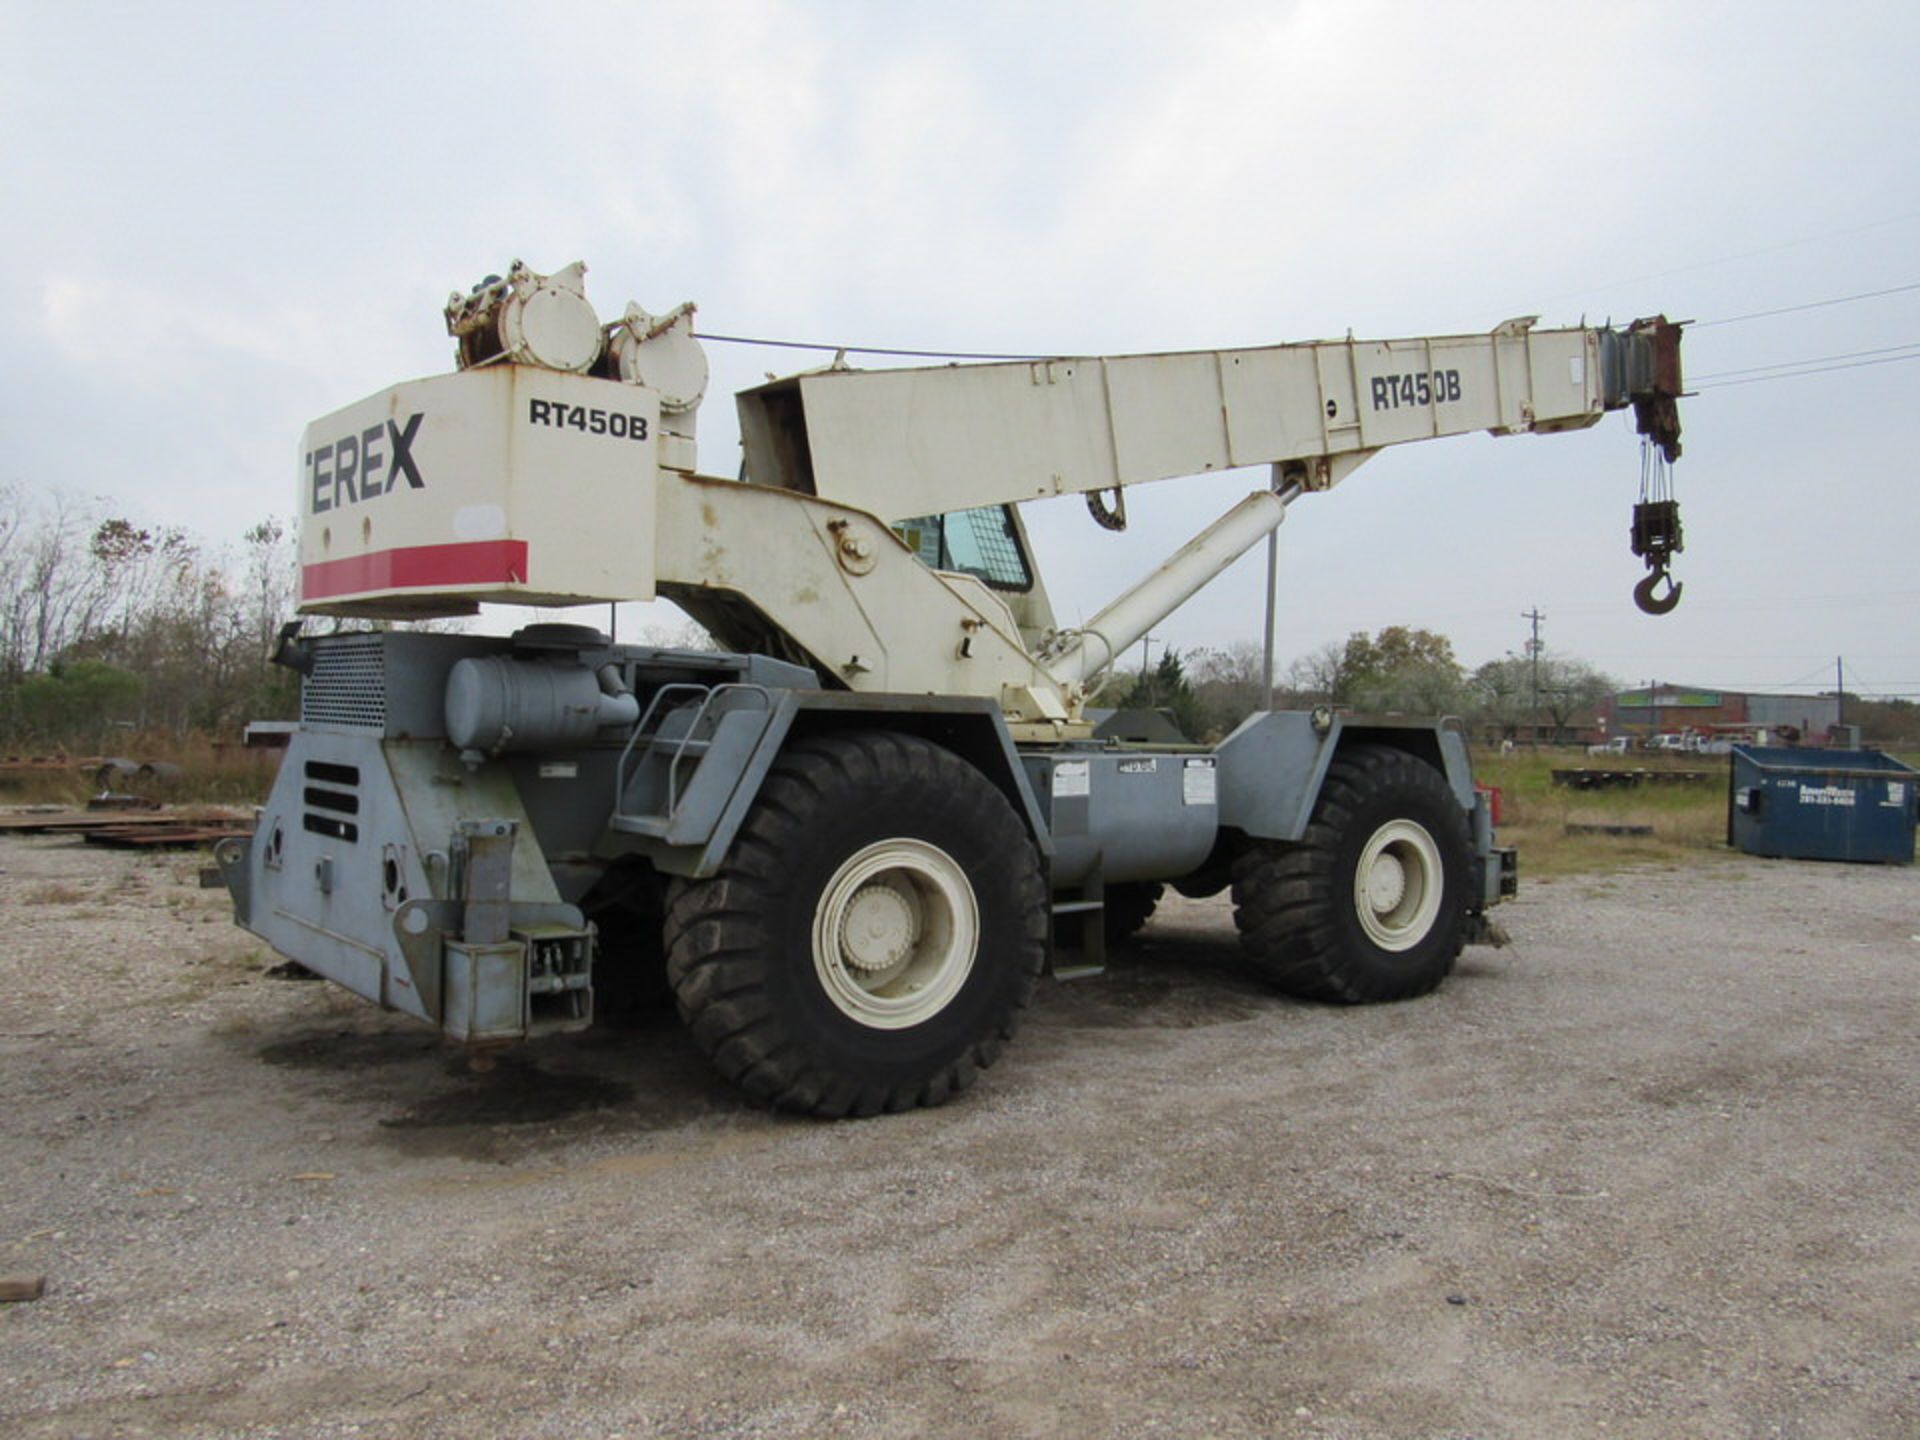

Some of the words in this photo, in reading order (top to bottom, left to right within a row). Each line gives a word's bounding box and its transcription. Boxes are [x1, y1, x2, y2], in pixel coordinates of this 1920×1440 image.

[1371, 369, 1461, 411] RT450B
[529, 398, 648, 442] RT450B
[306, 411, 425, 515] EREX
